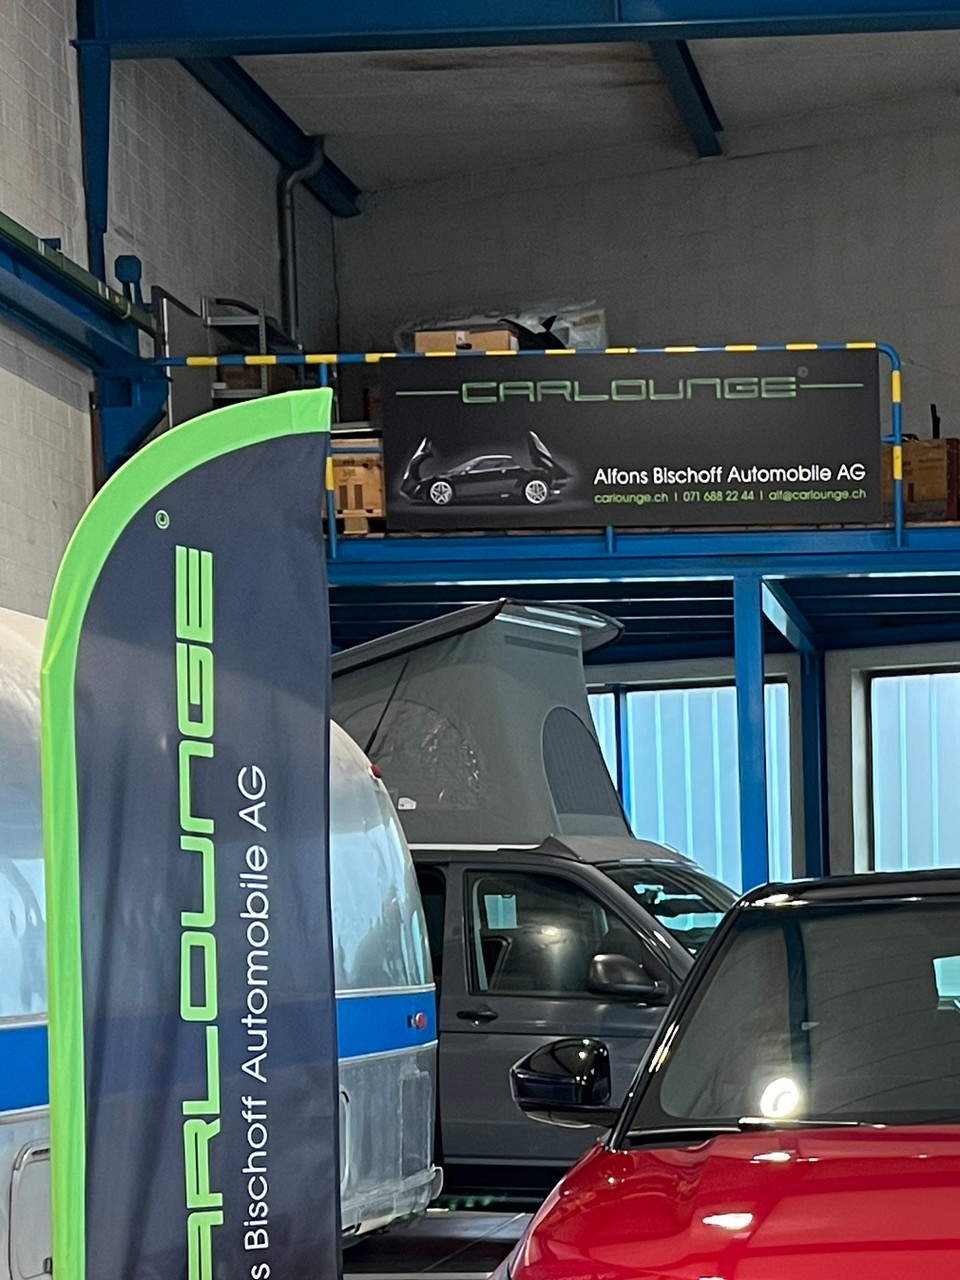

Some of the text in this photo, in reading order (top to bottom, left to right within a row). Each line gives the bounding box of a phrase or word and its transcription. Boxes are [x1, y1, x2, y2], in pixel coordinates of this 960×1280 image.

[461, 376, 797, 404] CARLOUNGE
[593, 463, 866, 485] Alfons Bischoff Automobile AG
[594, 492, 669, 505] carlounge.ch
[682, 490, 701, 502] 071
[703, 490, 723, 502] 688
[725, 490, 739, 502] 22
[740, 490, 755, 501] 44
[768, 488, 867, 502] alf@carlounge.ch
[237, 765, 268, 832] AG
[239, 845, 271, 1083] Automobile
[241, 1095, 269, 1250] Bischoff
